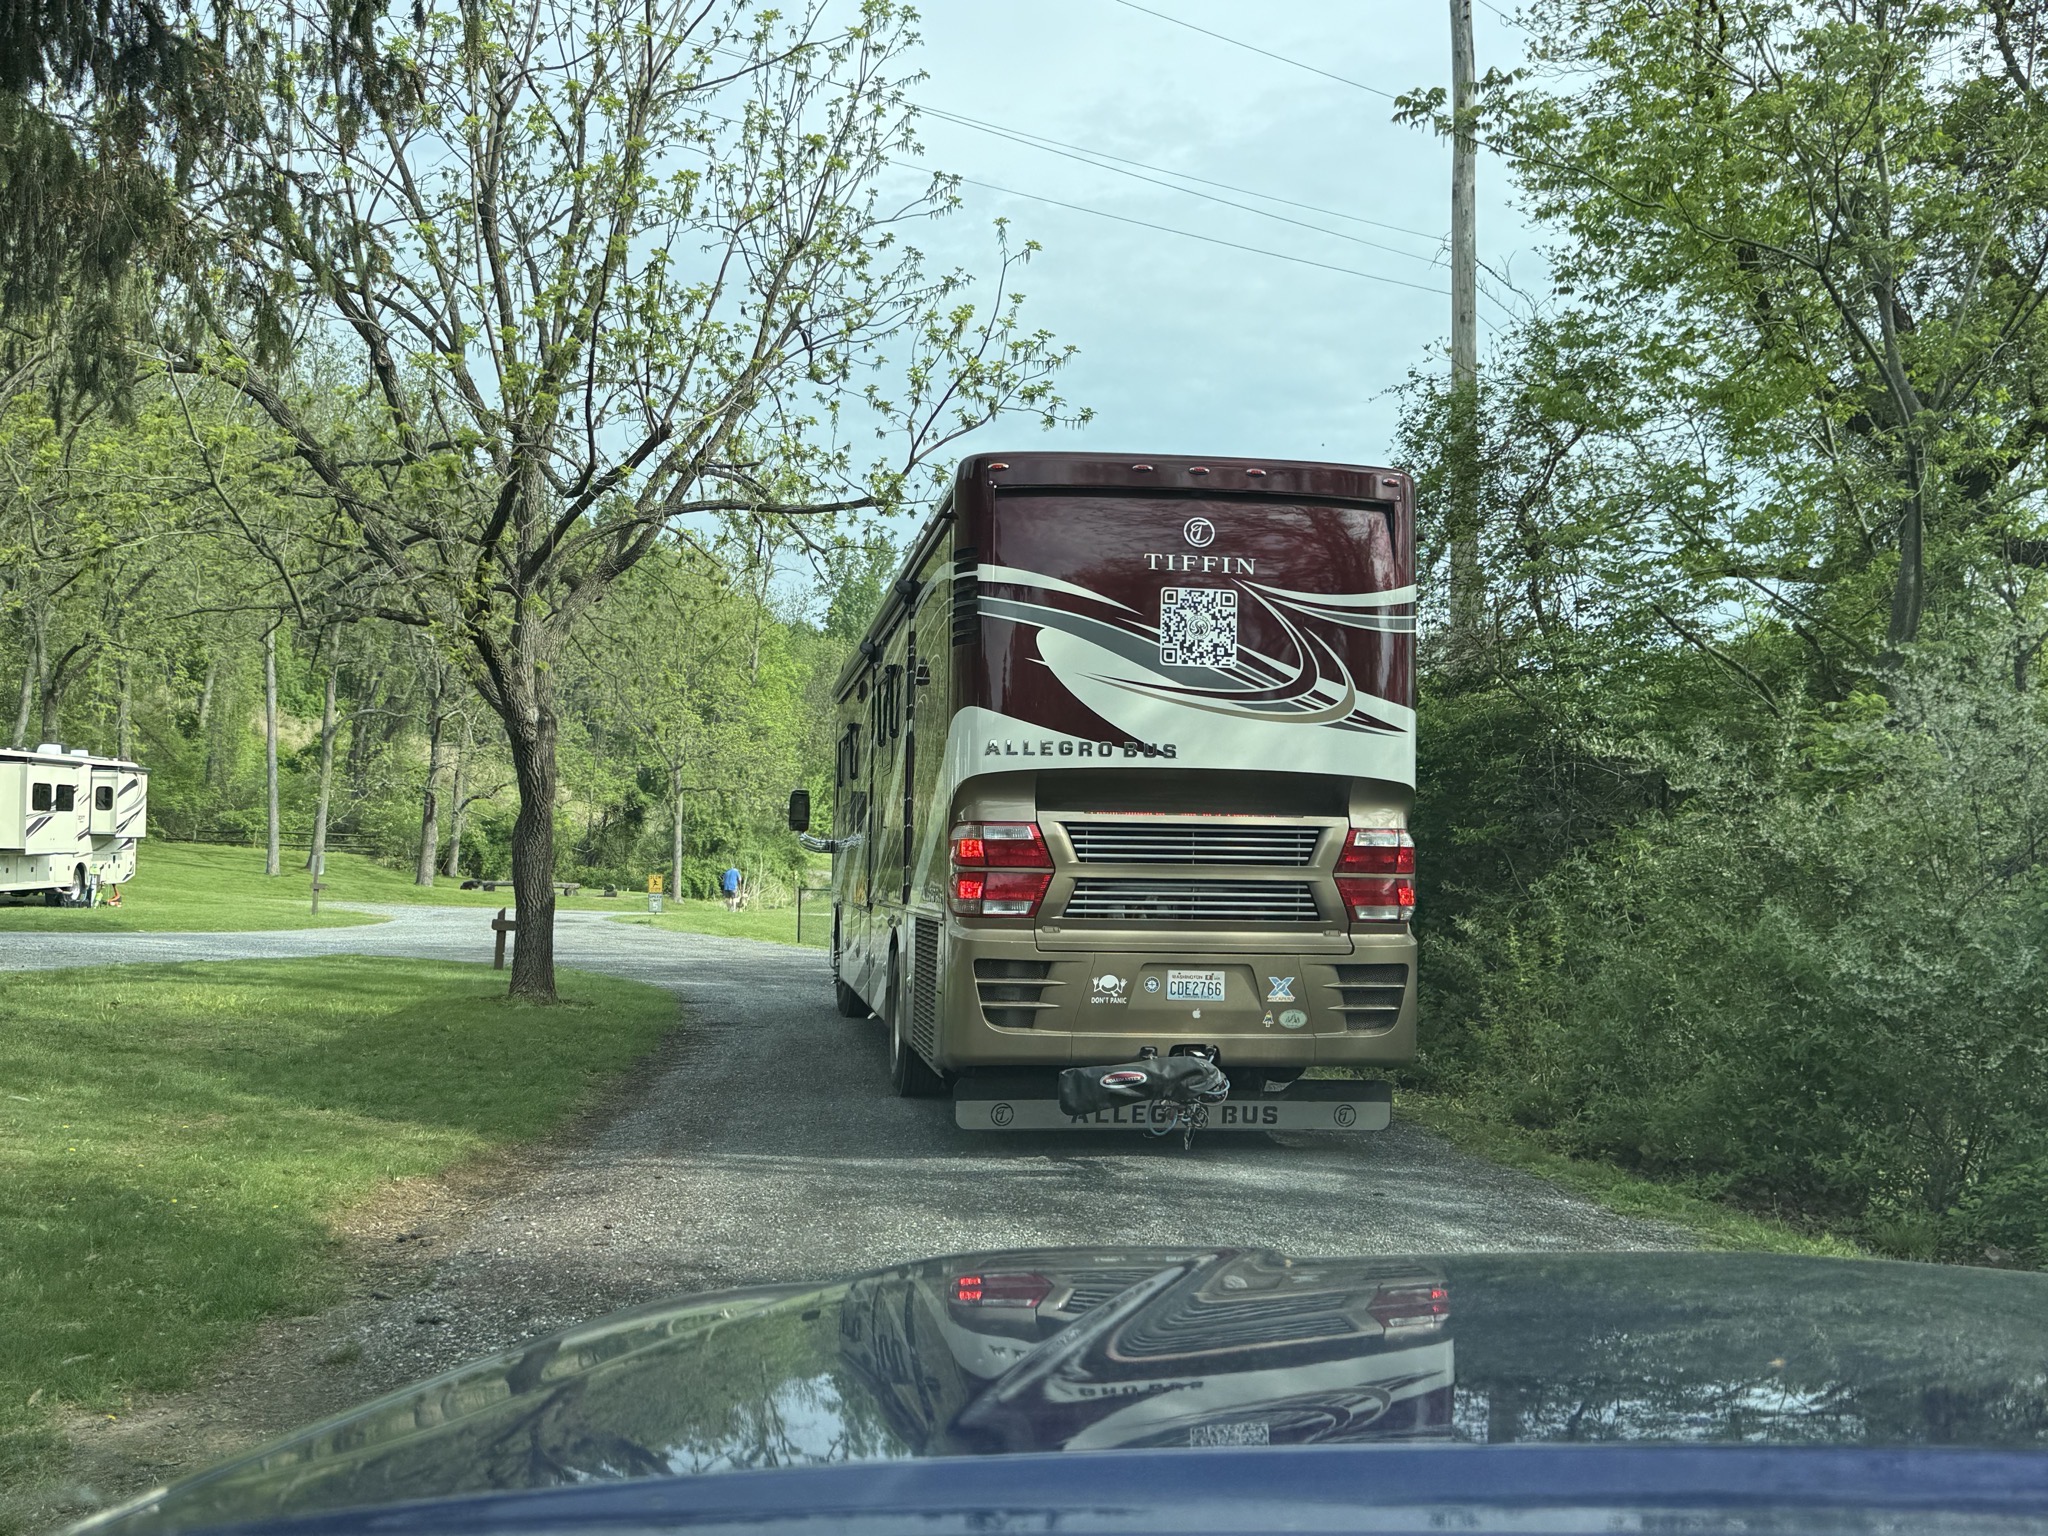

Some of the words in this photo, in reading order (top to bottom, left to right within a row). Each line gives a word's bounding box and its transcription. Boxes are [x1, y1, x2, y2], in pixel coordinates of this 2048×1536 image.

[1143, 553, 1257, 575] TIFFIN
[984, 739, 1113, 758] ALLEGRO
[1123, 741, 1178, 759] BUS
[1170, 981, 1222, 996] CDE2766
[1221, 1105, 1279, 1124] BUS
